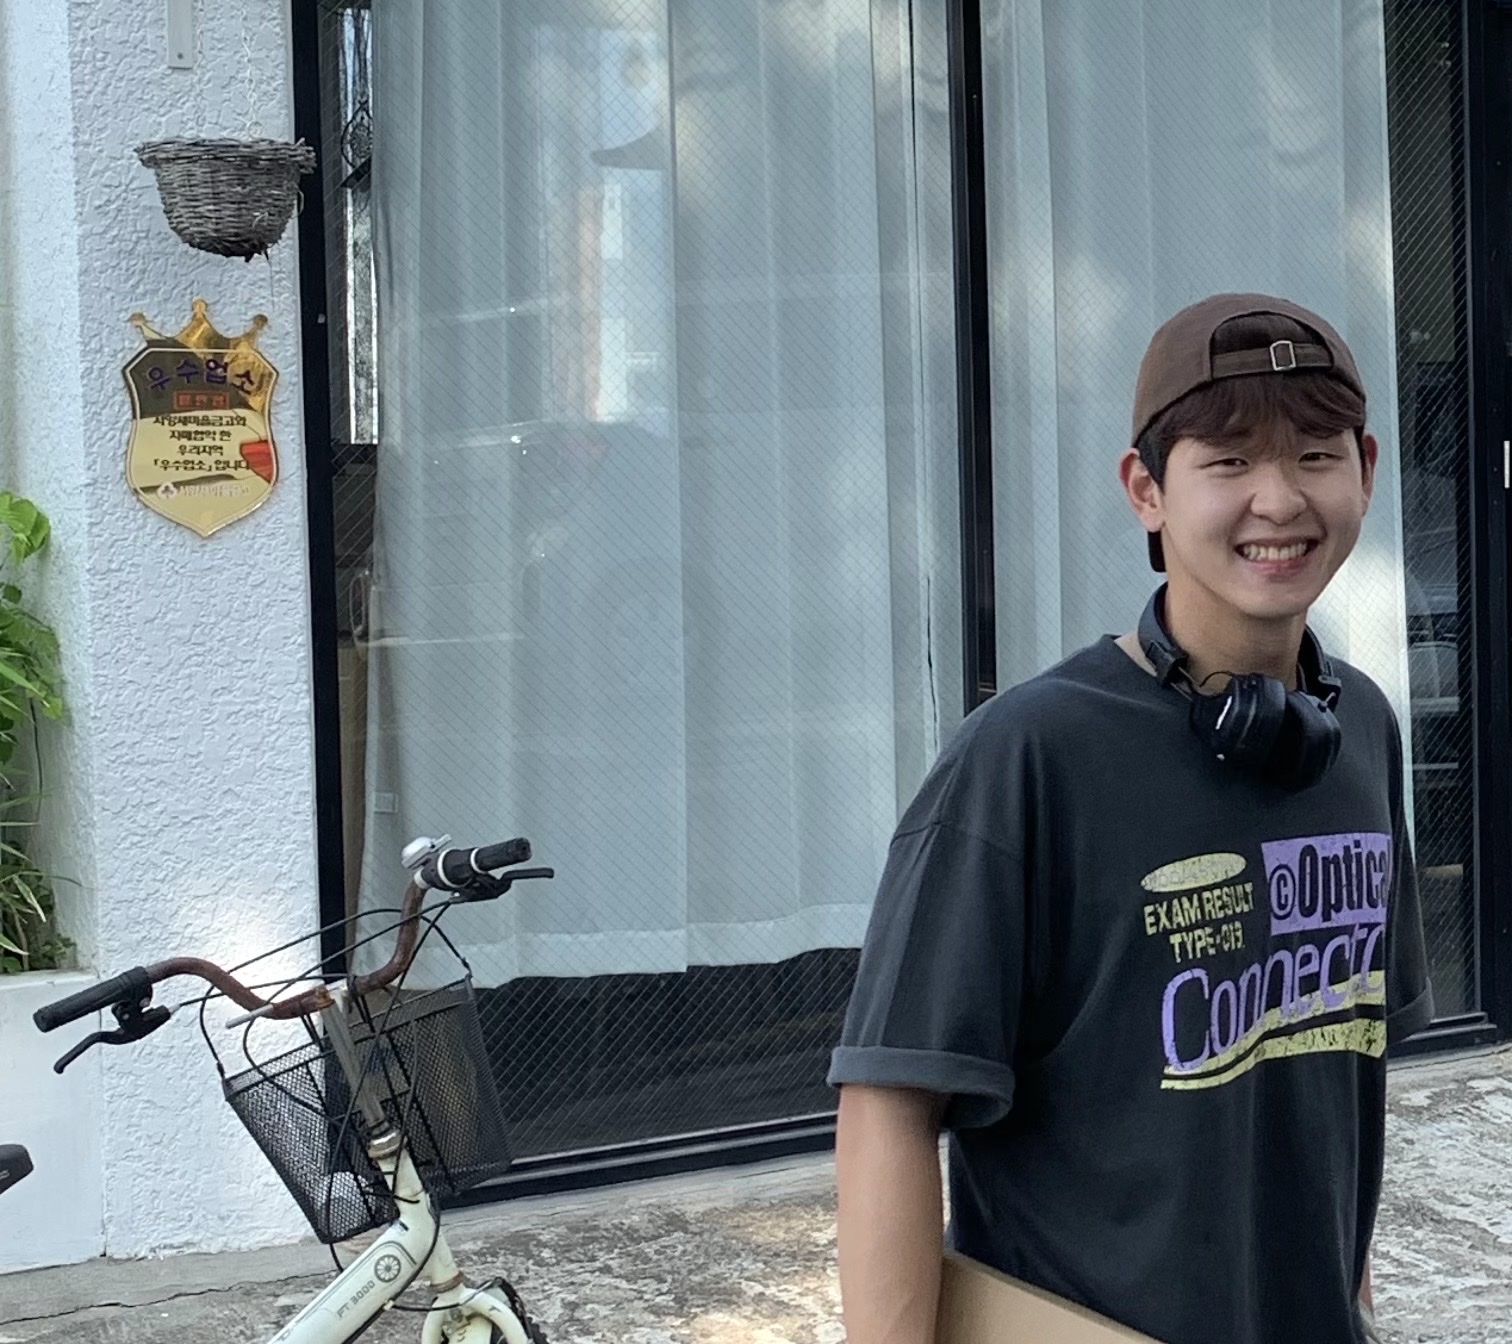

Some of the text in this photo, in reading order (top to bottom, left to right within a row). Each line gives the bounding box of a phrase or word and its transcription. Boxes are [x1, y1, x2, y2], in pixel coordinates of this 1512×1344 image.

[148, 358, 254, 394] 우수업소
[176, 444, 224, 456] 우리지역
[214, 458, 250, 471] 입니다
[1143, 882, 1254, 936] EXAM RESULT
[350, 1280, 376, 1305] 3000
